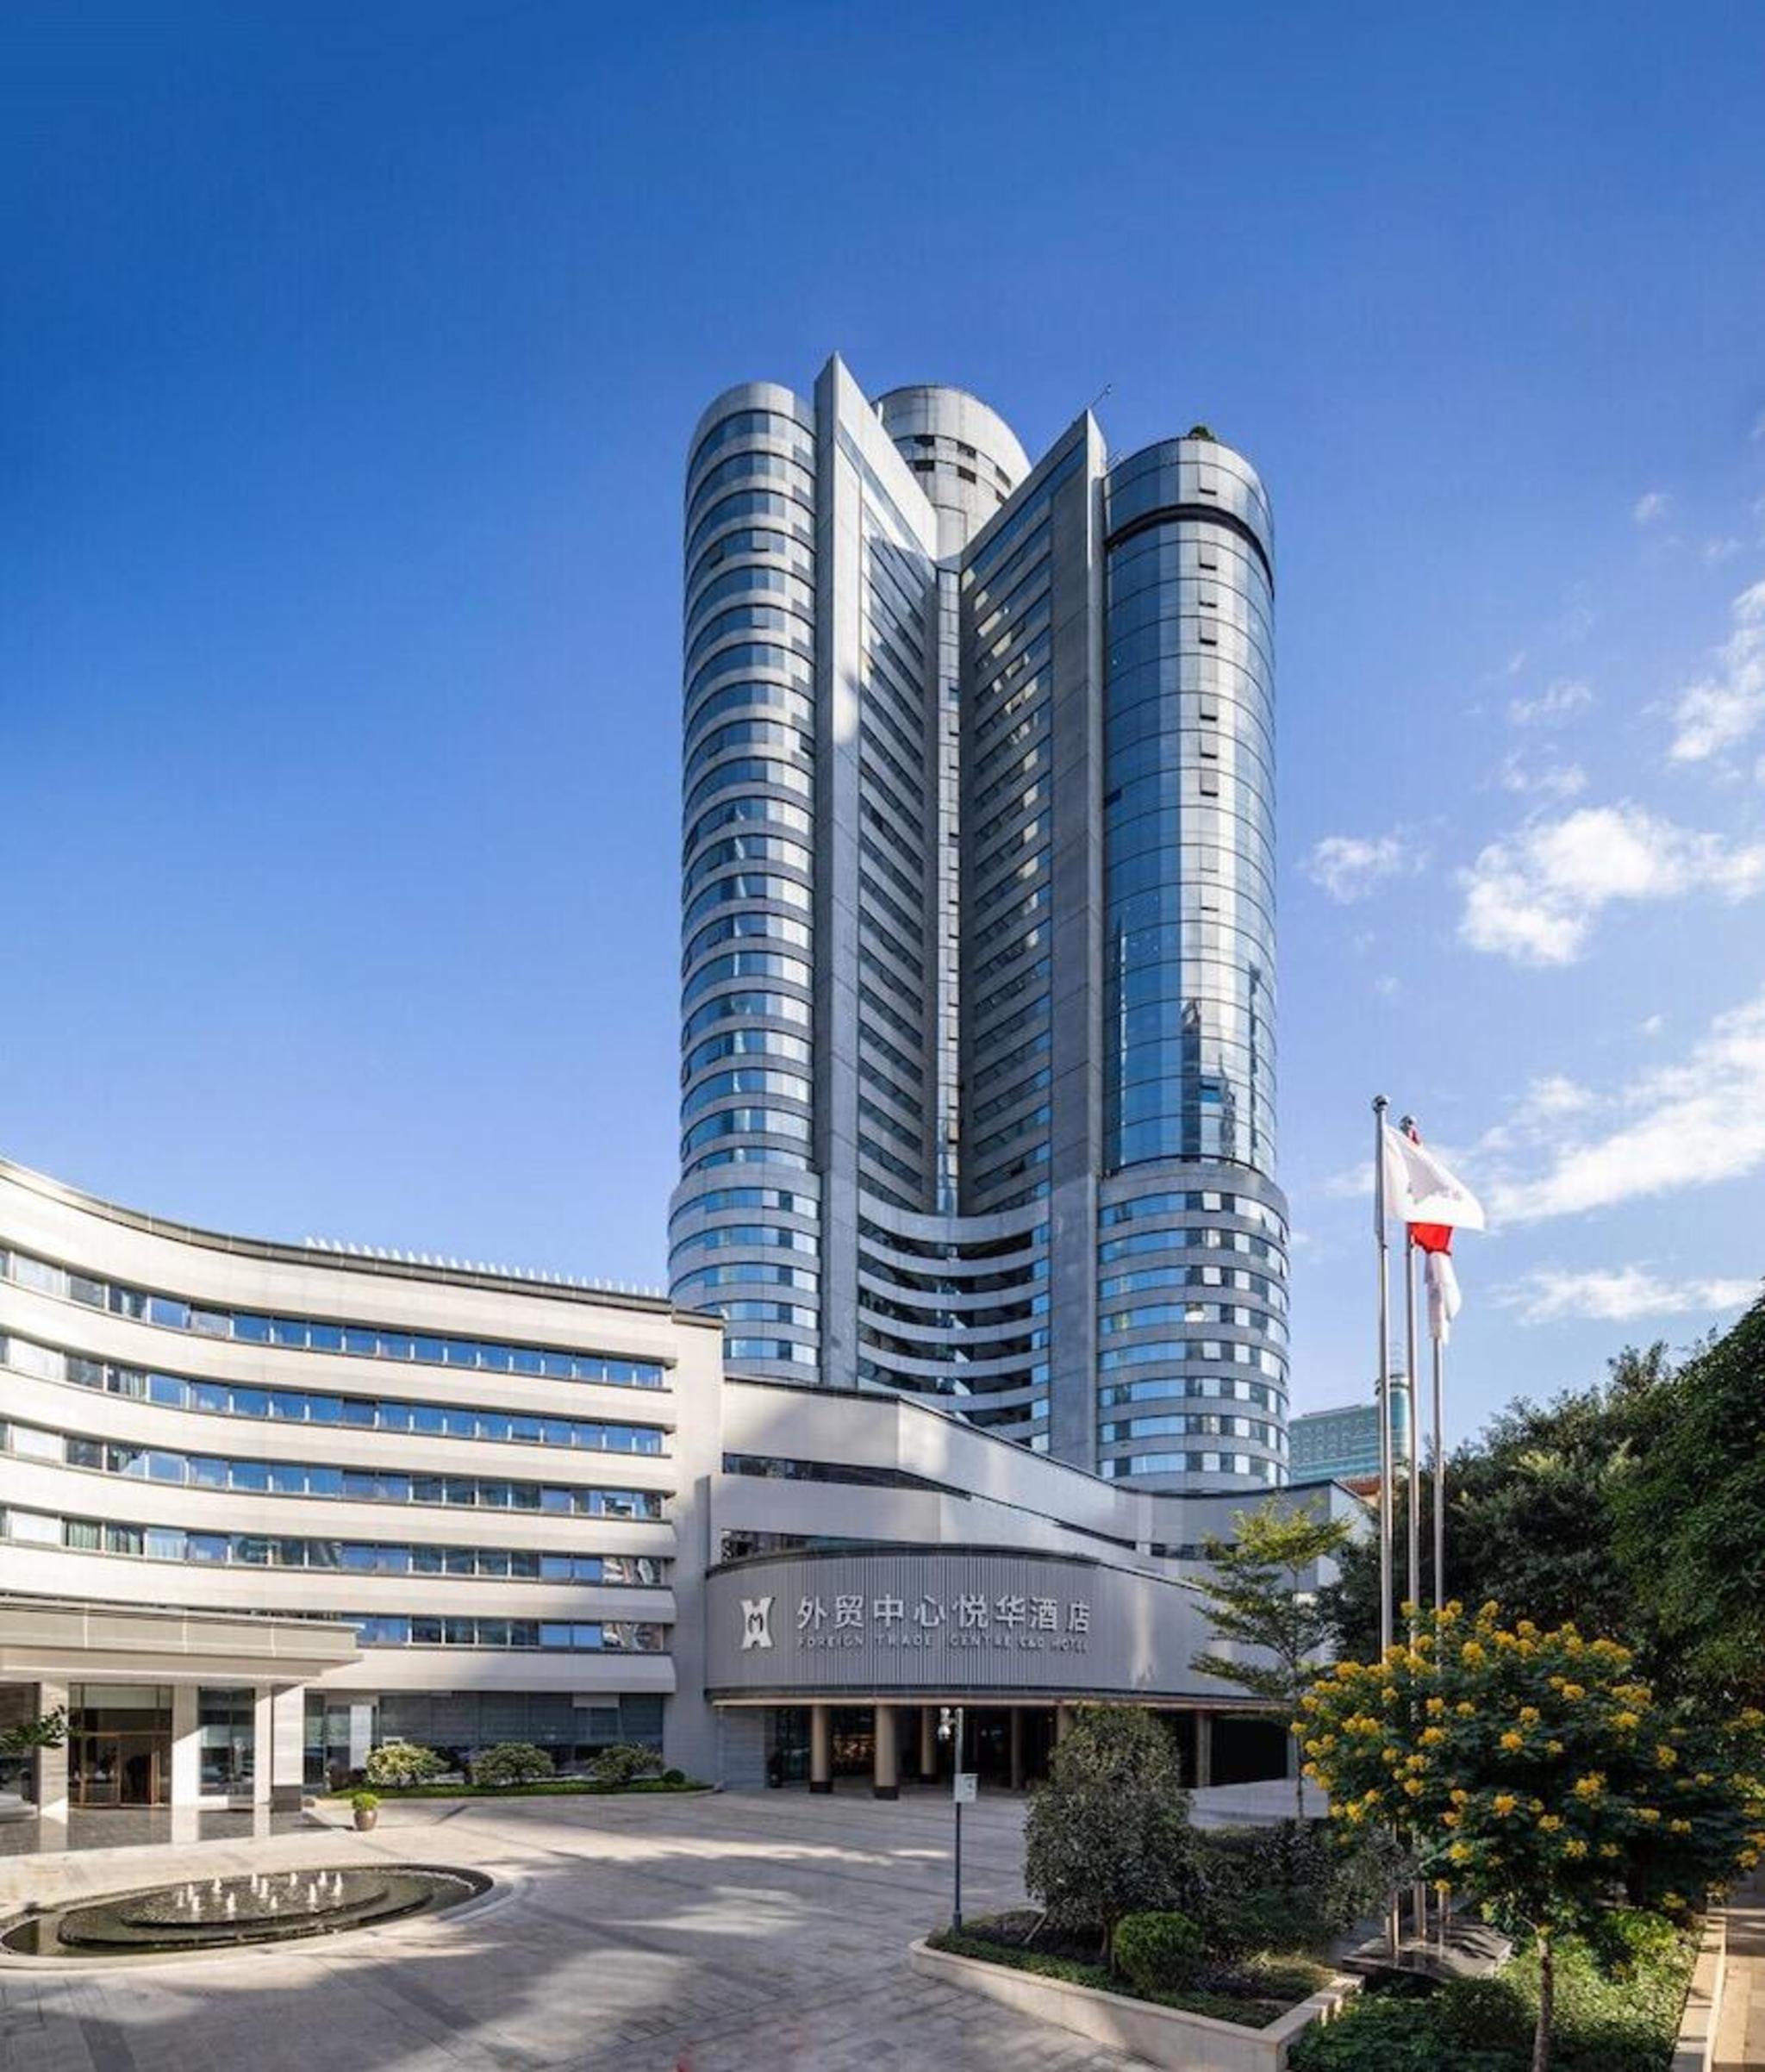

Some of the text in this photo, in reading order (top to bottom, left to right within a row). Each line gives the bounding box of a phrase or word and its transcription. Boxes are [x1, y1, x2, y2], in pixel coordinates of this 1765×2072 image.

[797, 1594, 1090, 1633] 外贸中心悦华酒店
[799, 1636, 864, 1647] FOREIGN
[877, 1636, 931, 1647] TRADE
[951, 1635, 1011, 1647] CENTRE
[1051, 1638, 1088, 1652] HOTEL
